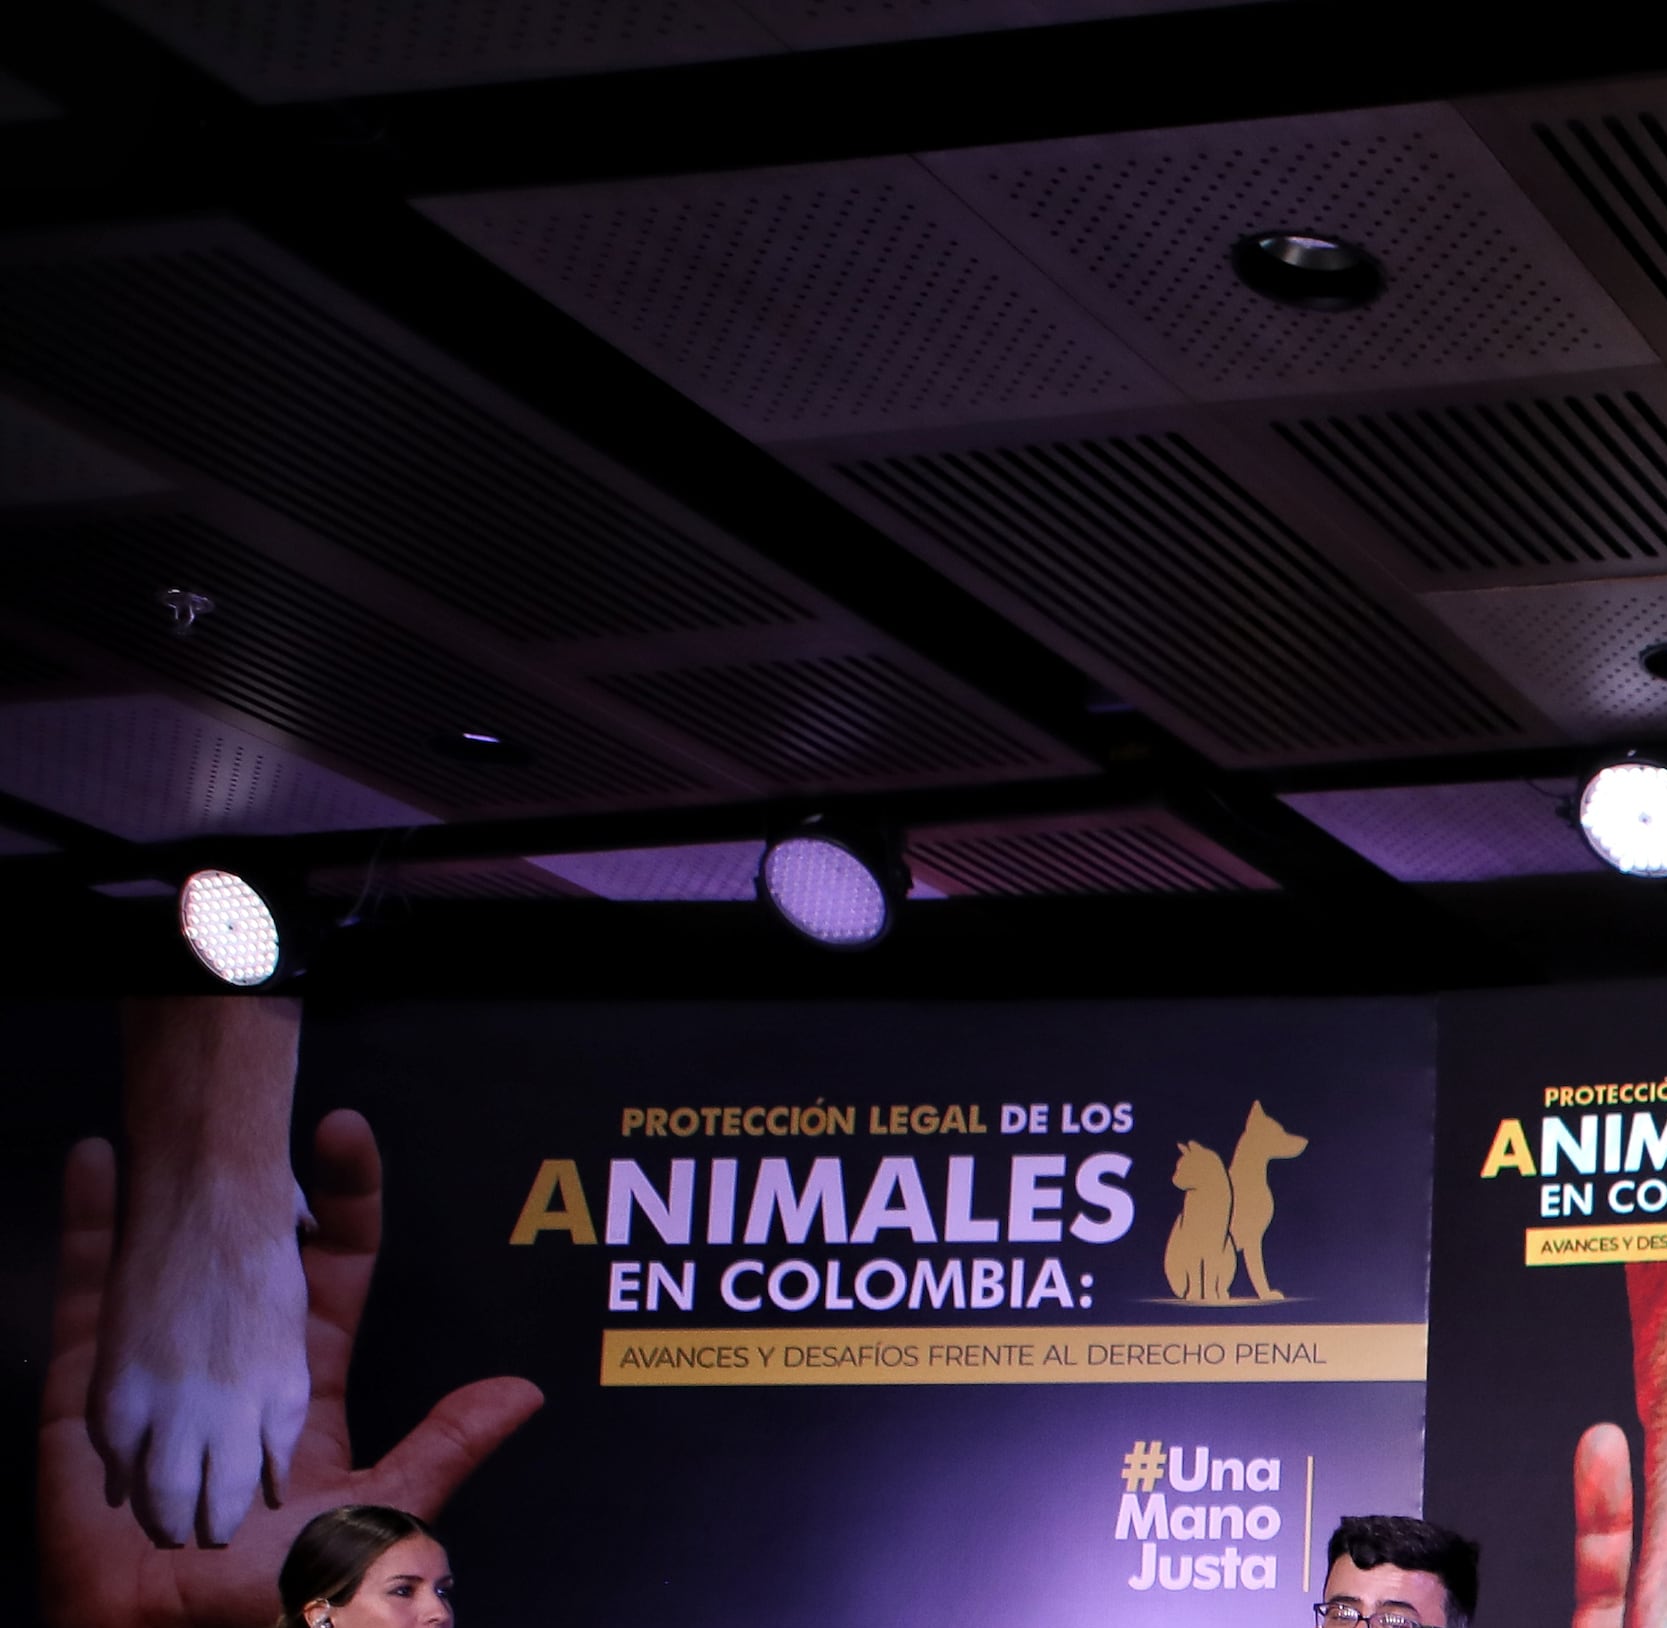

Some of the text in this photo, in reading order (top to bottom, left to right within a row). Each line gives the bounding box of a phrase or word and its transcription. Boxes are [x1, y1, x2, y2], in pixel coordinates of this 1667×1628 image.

[620, 1098, 1134, 1138] PROTECCIÓN LEGAL DE LOS
[509, 1153, 1136, 1245] ANIMALES
[1540, 1183, 1592, 1217] EN
[1540, 1236, 1620, 1255] AVANCES
[1622, 1235, 1633, 1251] Y
[608, 1258, 1095, 1311] EN COLOMBIA:
[620, 1339, 1327, 1369] AVANCES Y DESAFÍOS FRENTE AL DERECHO PENAL
[1120, 1440, 1280, 1494] #Una
[1114, 1495, 1281, 1541] Mano
[1128, 1542, 1277, 1592] Justa
